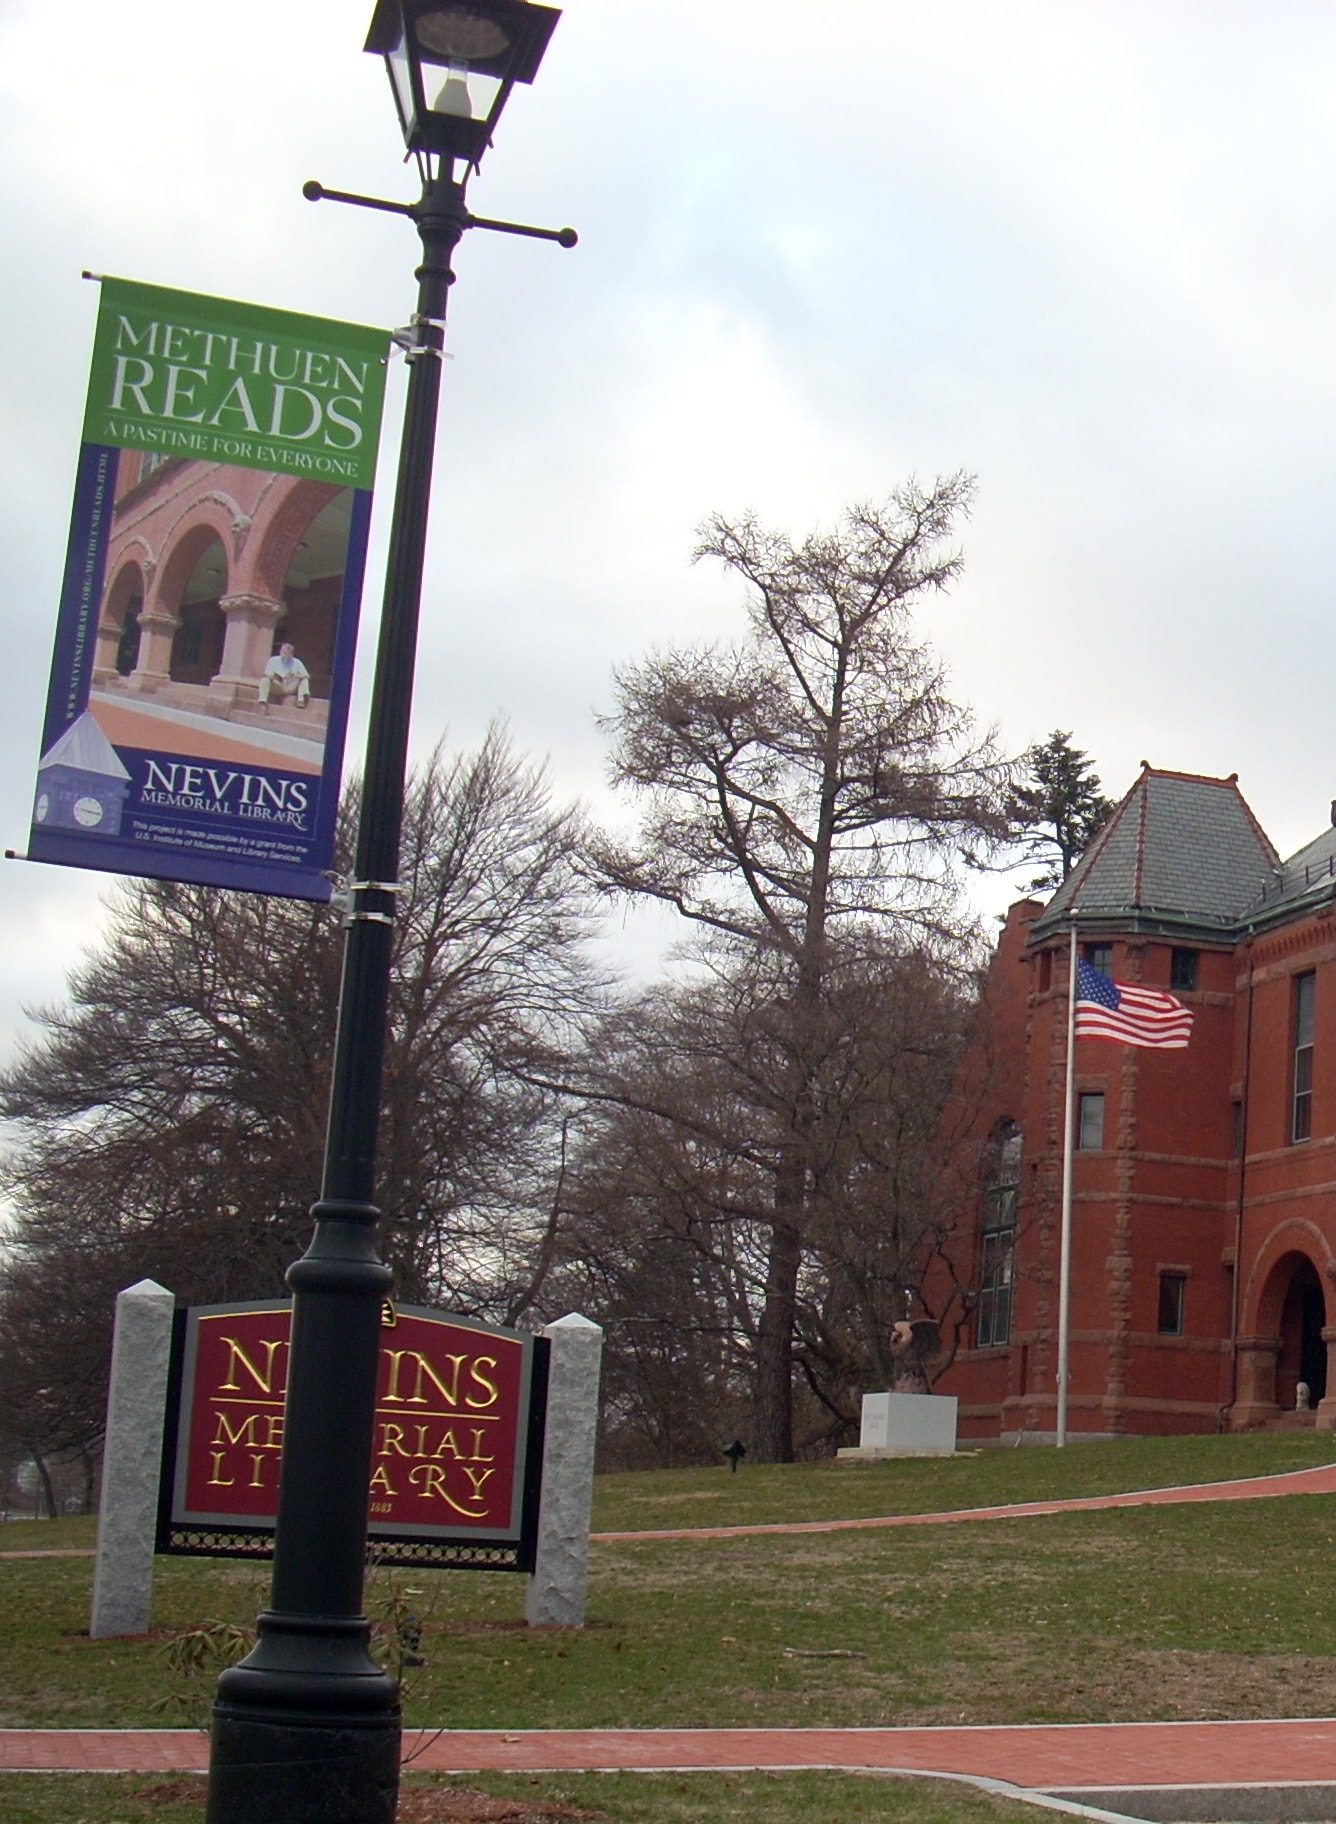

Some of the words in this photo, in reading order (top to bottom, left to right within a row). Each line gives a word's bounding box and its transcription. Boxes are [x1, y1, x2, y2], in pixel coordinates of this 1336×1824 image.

[113, 315, 369, 394] METHUEN
[107, 354, 363, 450] READS
[104, 421, 119, 436] A
[122, 422, 210, 450] PASTIME
[213, 438, 252, 458] FOR
[256, 447, 359, 478] EVERYONE
[140, 790, 232, 814] MEMORIAL
[239, 804, 308, 832] LIBRARY
[143, 759, 308, 812] NEVINS
[132, 820, 148, 830] This
[149, 824, 176, 835] project
[177, 827, 183, 835] is
[184, 828, 206, 838] made
[206, 831, 238, 843] possible
[239, 835, 249, 846] by
[256, 839, 277, 849] grant
[277, 841, 295, 852] from
[295, 844, 308, 854] the
[135, 832, 150, 841] U.S.
[153, 834, 184, 845] Institute
[184, 838, 193, 847] of
[193, 841, 226, 851] Museum
[226, 845, 241, 854] and
[242, 847, 268, 859] Library
[218, 1336, 498, 1408] NINS
[210, 1411, 495, 1462] MERIAL
[207, 1451, 495, 1517] LIARY
